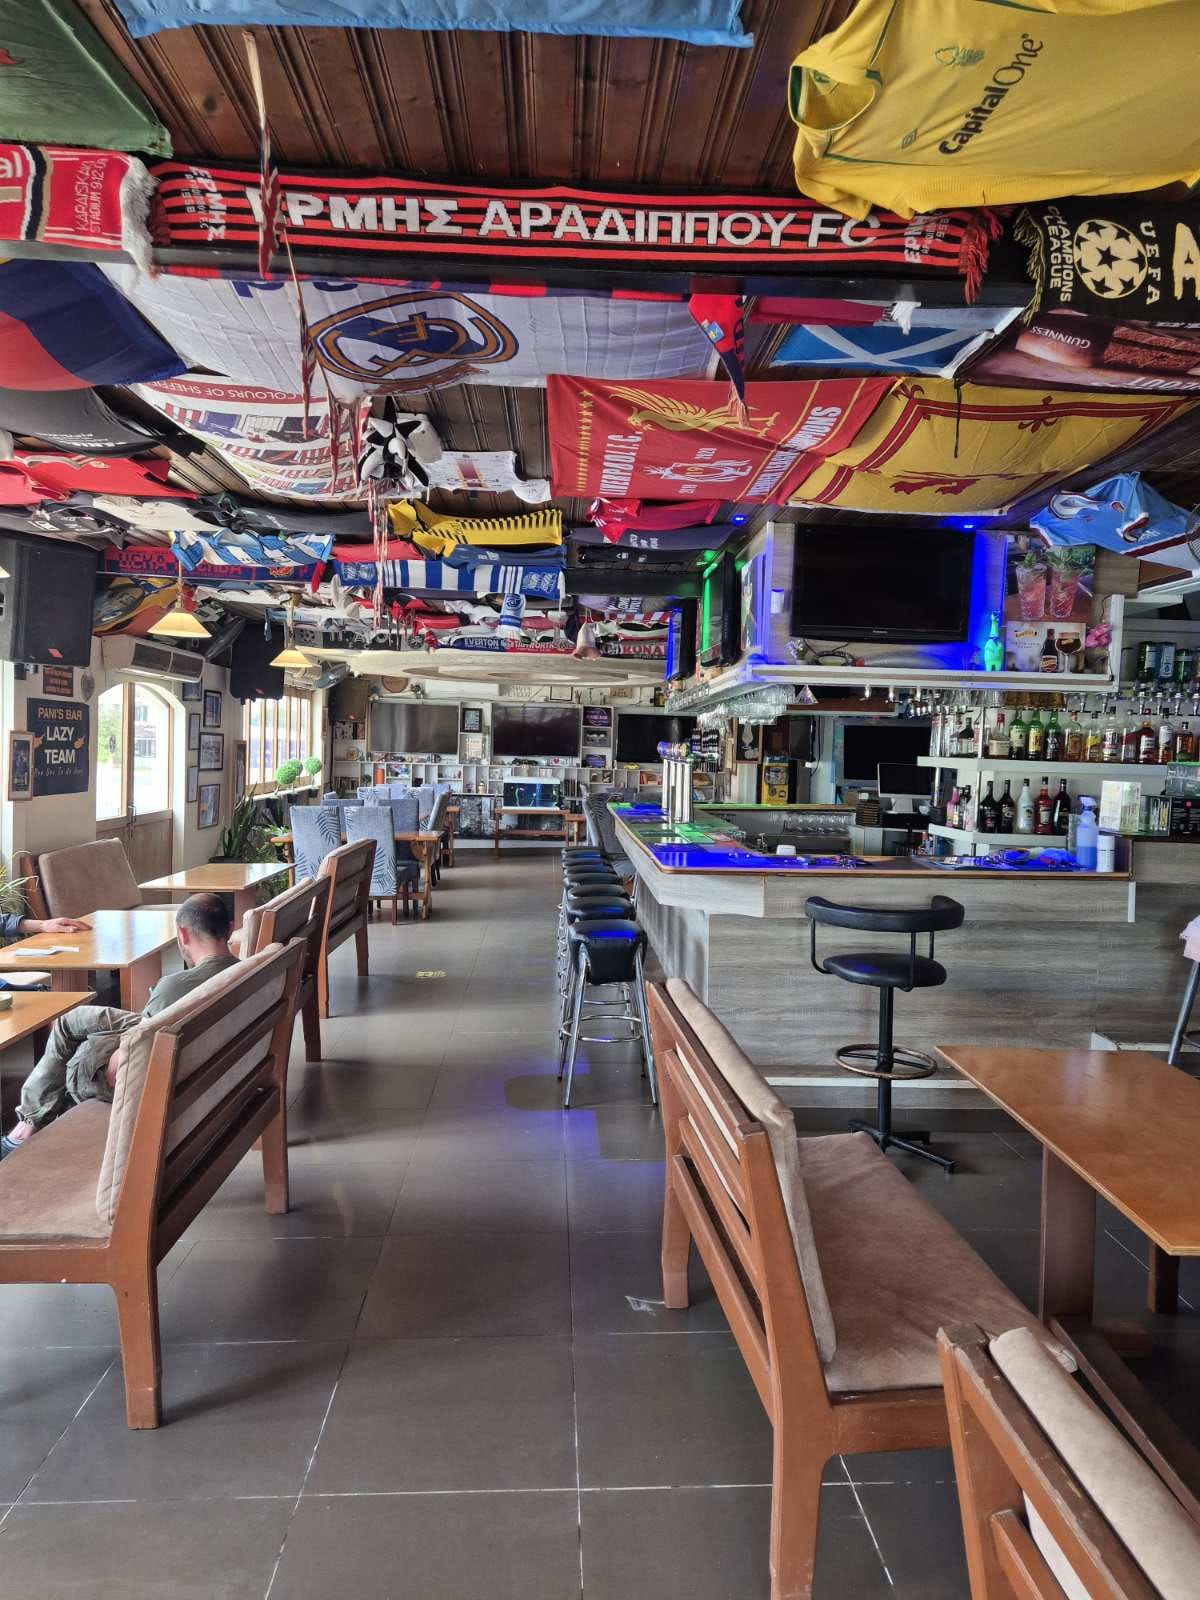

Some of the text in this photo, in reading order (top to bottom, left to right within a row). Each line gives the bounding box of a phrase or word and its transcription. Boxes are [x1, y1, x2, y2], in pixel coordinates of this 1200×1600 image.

[88, 190, 101, 233] STADIUM
[478, 200, 795, 247] ΑΡΑΔΙΠΠΟΥ
[807, 211, 881, 248] FC
[1044, 214, 1062, 289] LEAGUE
[1047, 206, 1072, 303] CHAMPIONS
[1138, 220, 1161, 305] UEFA
[1030, 325, 1091, 349] GUINNESS
[205, 387, 225, 398] OF
[227, 388, 297, 400] COLOURS
[599, 449, 637, 496] LIVERPOOL
[463, 637, 500, 648] EVERTON
[65, 708, 82, 721] BAR
[46, 725, 75, 742] LAZY
[44, 748, 76, 765] TEAM
